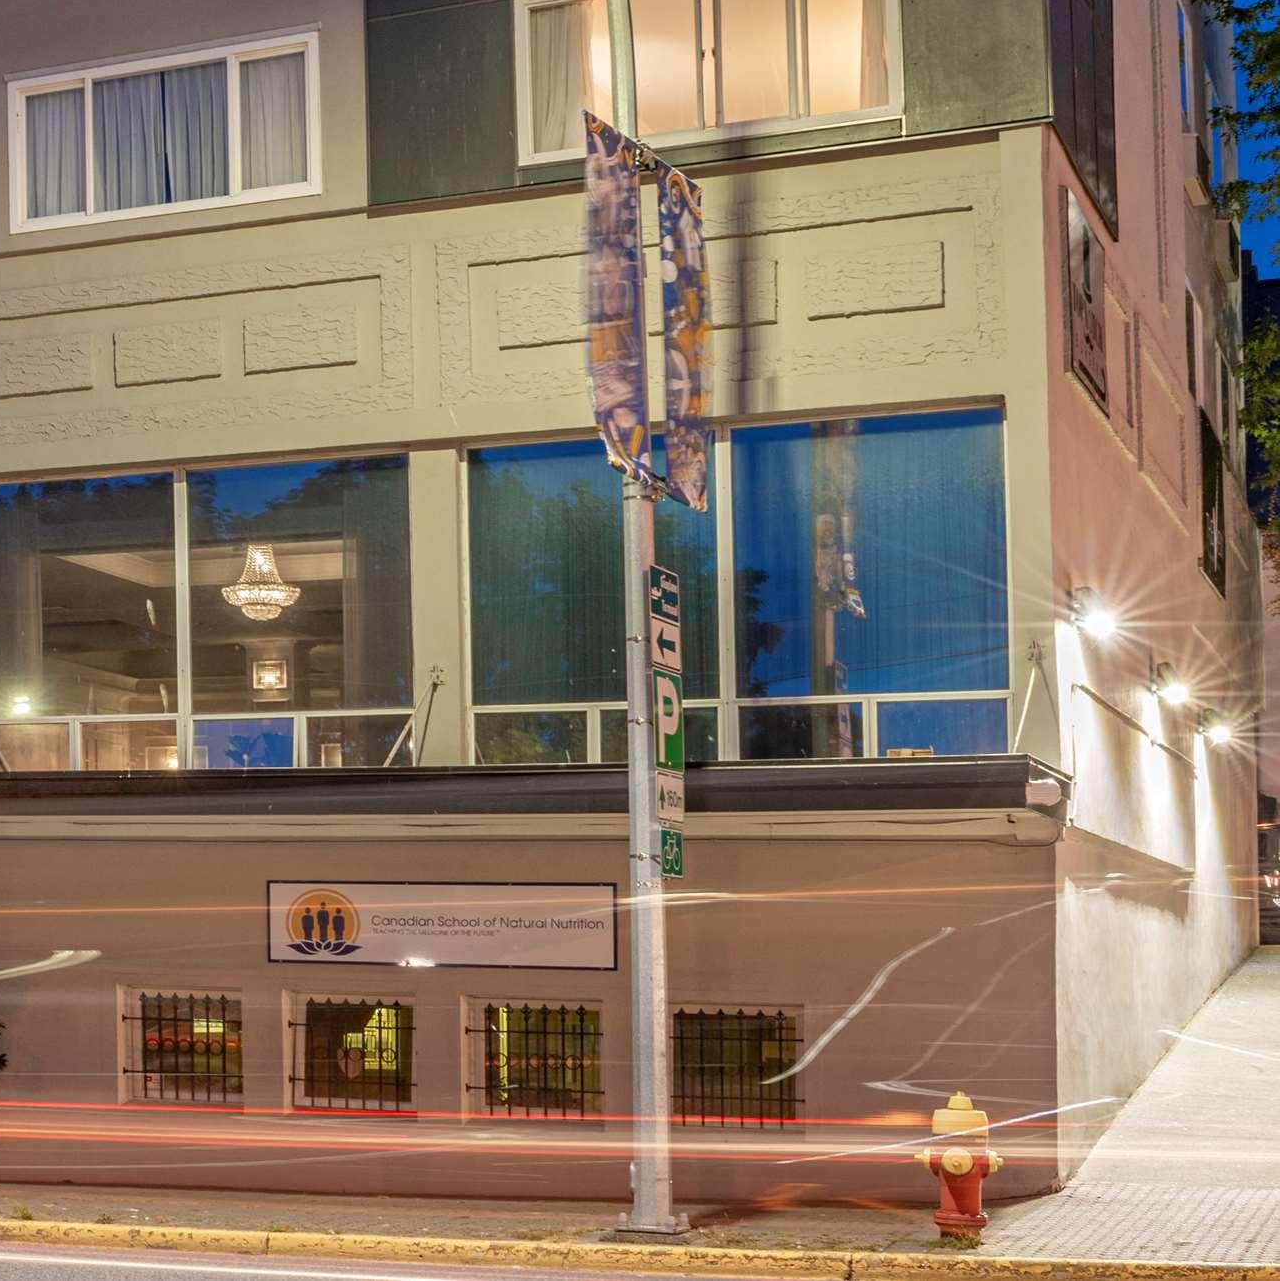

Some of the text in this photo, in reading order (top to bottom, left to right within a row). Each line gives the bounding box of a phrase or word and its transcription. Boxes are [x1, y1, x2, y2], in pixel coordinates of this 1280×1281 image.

[656, 675, 679, 764] P
[371, 914, 605, 930] Canadian School of Natural Nutrition
